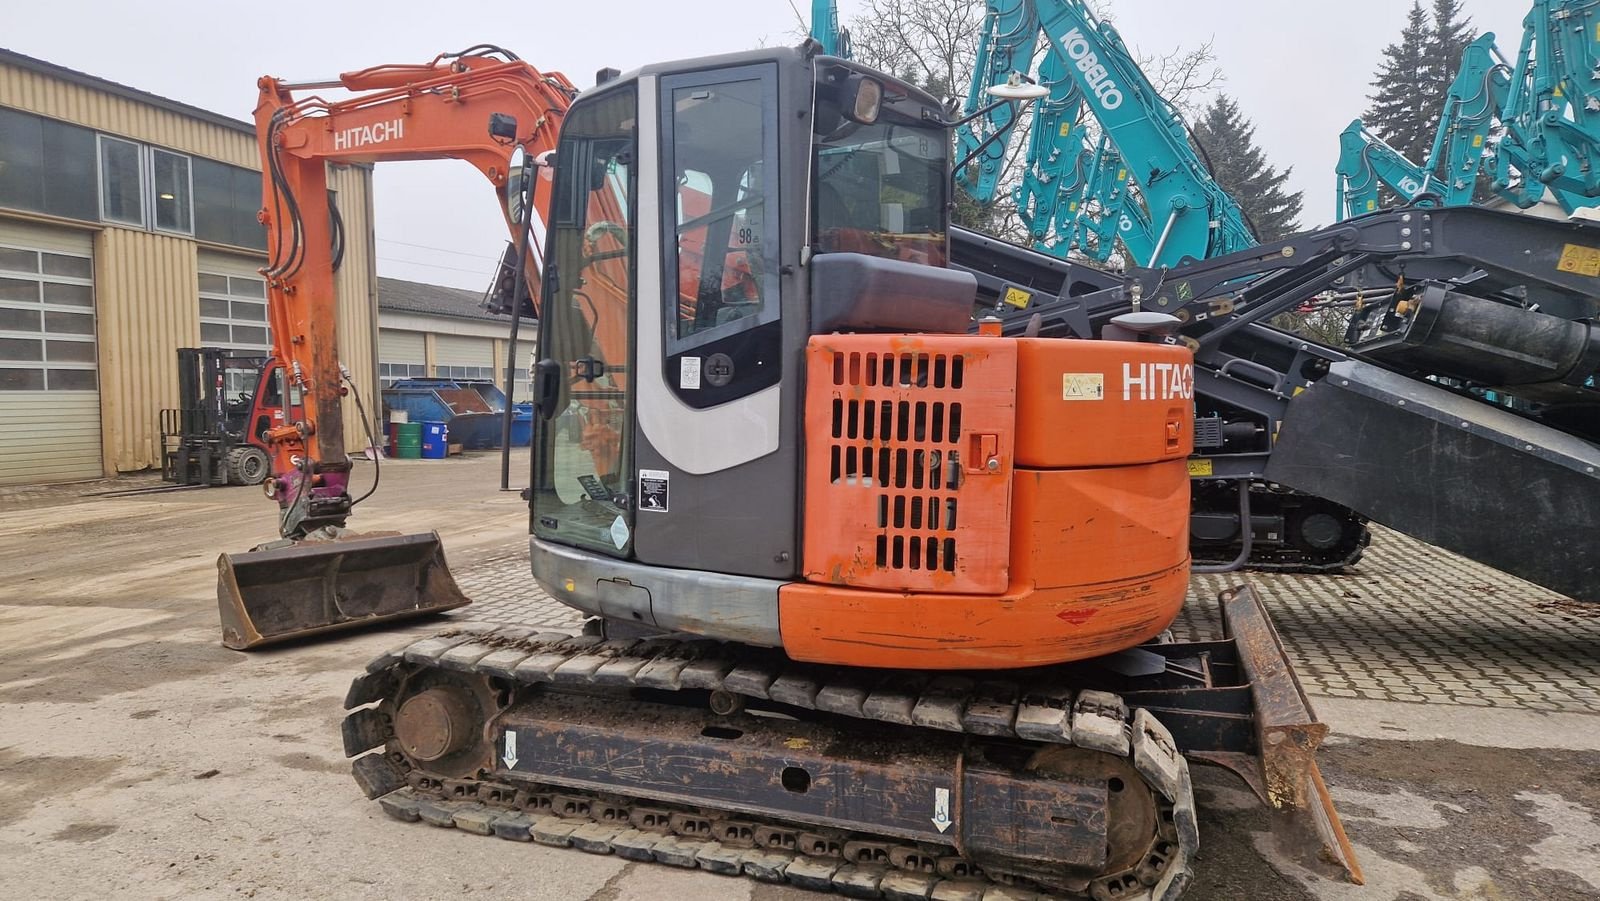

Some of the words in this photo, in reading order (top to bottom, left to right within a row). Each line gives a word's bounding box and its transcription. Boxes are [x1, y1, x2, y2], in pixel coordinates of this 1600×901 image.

[1059, 27, 1123, 110] KOBELCO
[335, 118, 404, 150] HITACHI
[739, 228, 752, 244] 98
